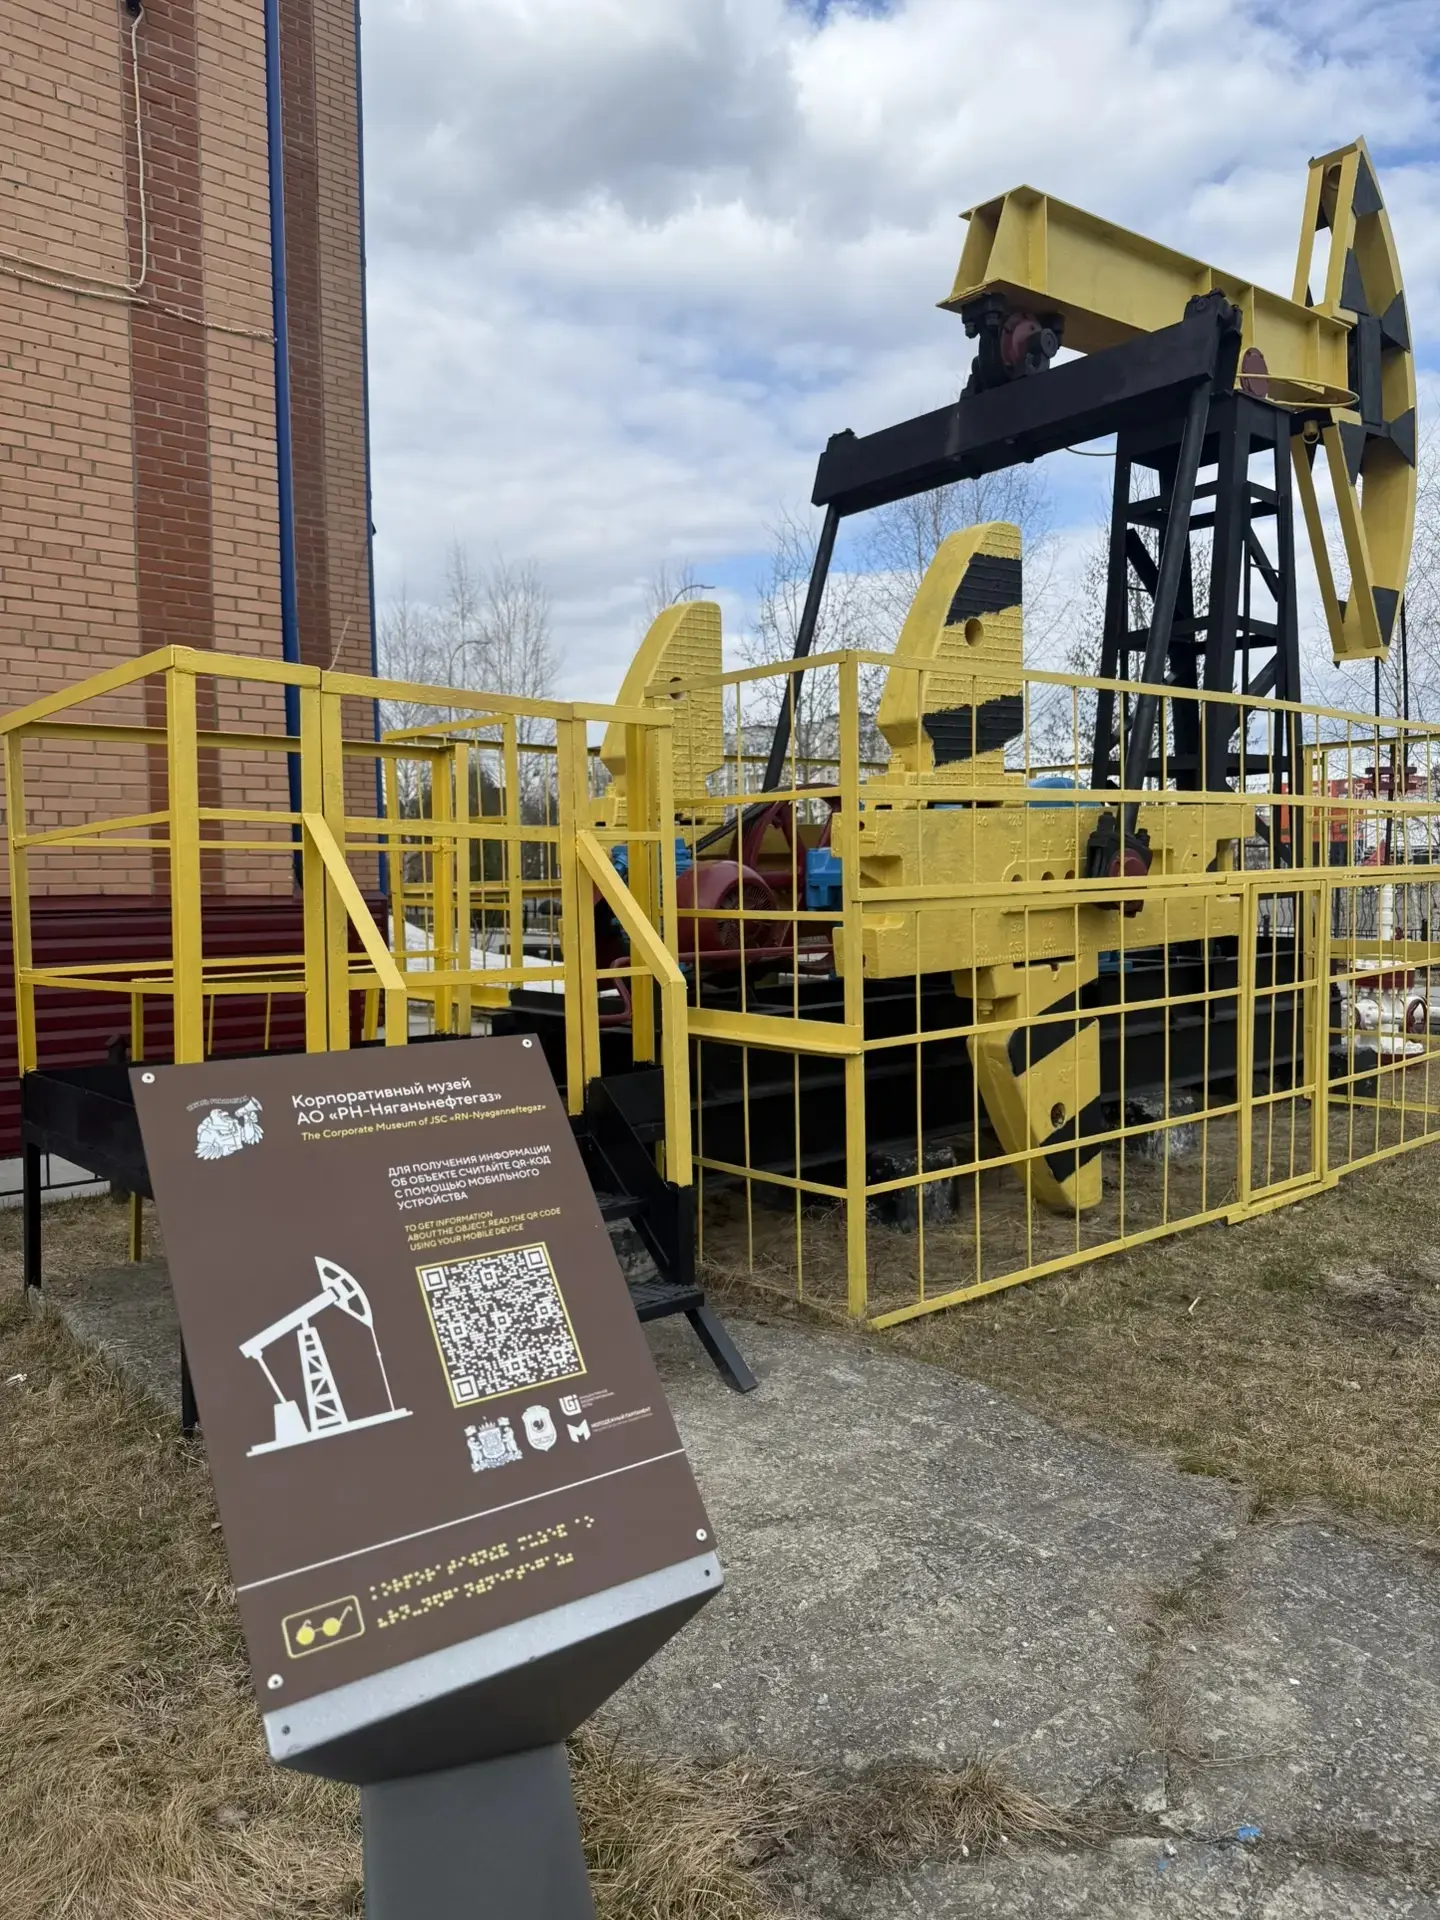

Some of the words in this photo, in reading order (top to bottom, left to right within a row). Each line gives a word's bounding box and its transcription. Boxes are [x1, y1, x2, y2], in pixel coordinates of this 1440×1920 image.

[291, 1082, 425, 1109] Корпоративный
[427, 1077, 472, 1097] музей
[296, 1109, 325, 1126] АО
[329, 1092, 502, 1122] «РН-Няганьнефтегаз»
[301, 1131, 321, 1142] The
[322, 1125, 374, 1139] Corporate
[376, 1119, 417, 1132] Museum
[419, 1116, 428, 1126] of
[429, 1114, 448, 1125] JSC
[388, 1165, 411, 1178] ДЛЯ
[412, 1155, 478, 1173] ПОЛУЧЕНИЯ
[478, 1144, 552, 1163] ИНФОРМАЦИИ
[391, 1177, 408, 1188] ОБ
[408, 1169, 458, 1185] ОБЪЕКТЕ
[458, 1160, 511, 1178] СЧИТАЙТЕ
[511, 1155, 552, 1169] QR-КОД
[394, 1189, 404, 1199] С
[404, 1179, 467, 1198] ПОМОЩЬЮ
[468, 1168, 540, 1187] МОБИЛЬНОГО
[397, 1191, 469, 1211] УСТРОЙСТВА
[404, 1223, 417, 1233] TO
[418, 1220, 435, 1231] GET
[435, 1210, 493, 1228] INFORMATION
[407, 1230, 436, 1242] ABOUT
[437, 1227, 454, 1237] THE
[488, 1217, 510, 1228] READ
[510, 1213, 526, 1224] THE
[527, 1211, 539, 1221] QR
[539, 1207, 561, 1218] CODE
[410, 1239, 437, 1251] USING
[438, 1234, 462, 1246] YOUR
[463, 1227, 494, 1242] MOBILE
[495, 1223, 524, 1236] DEVICE
